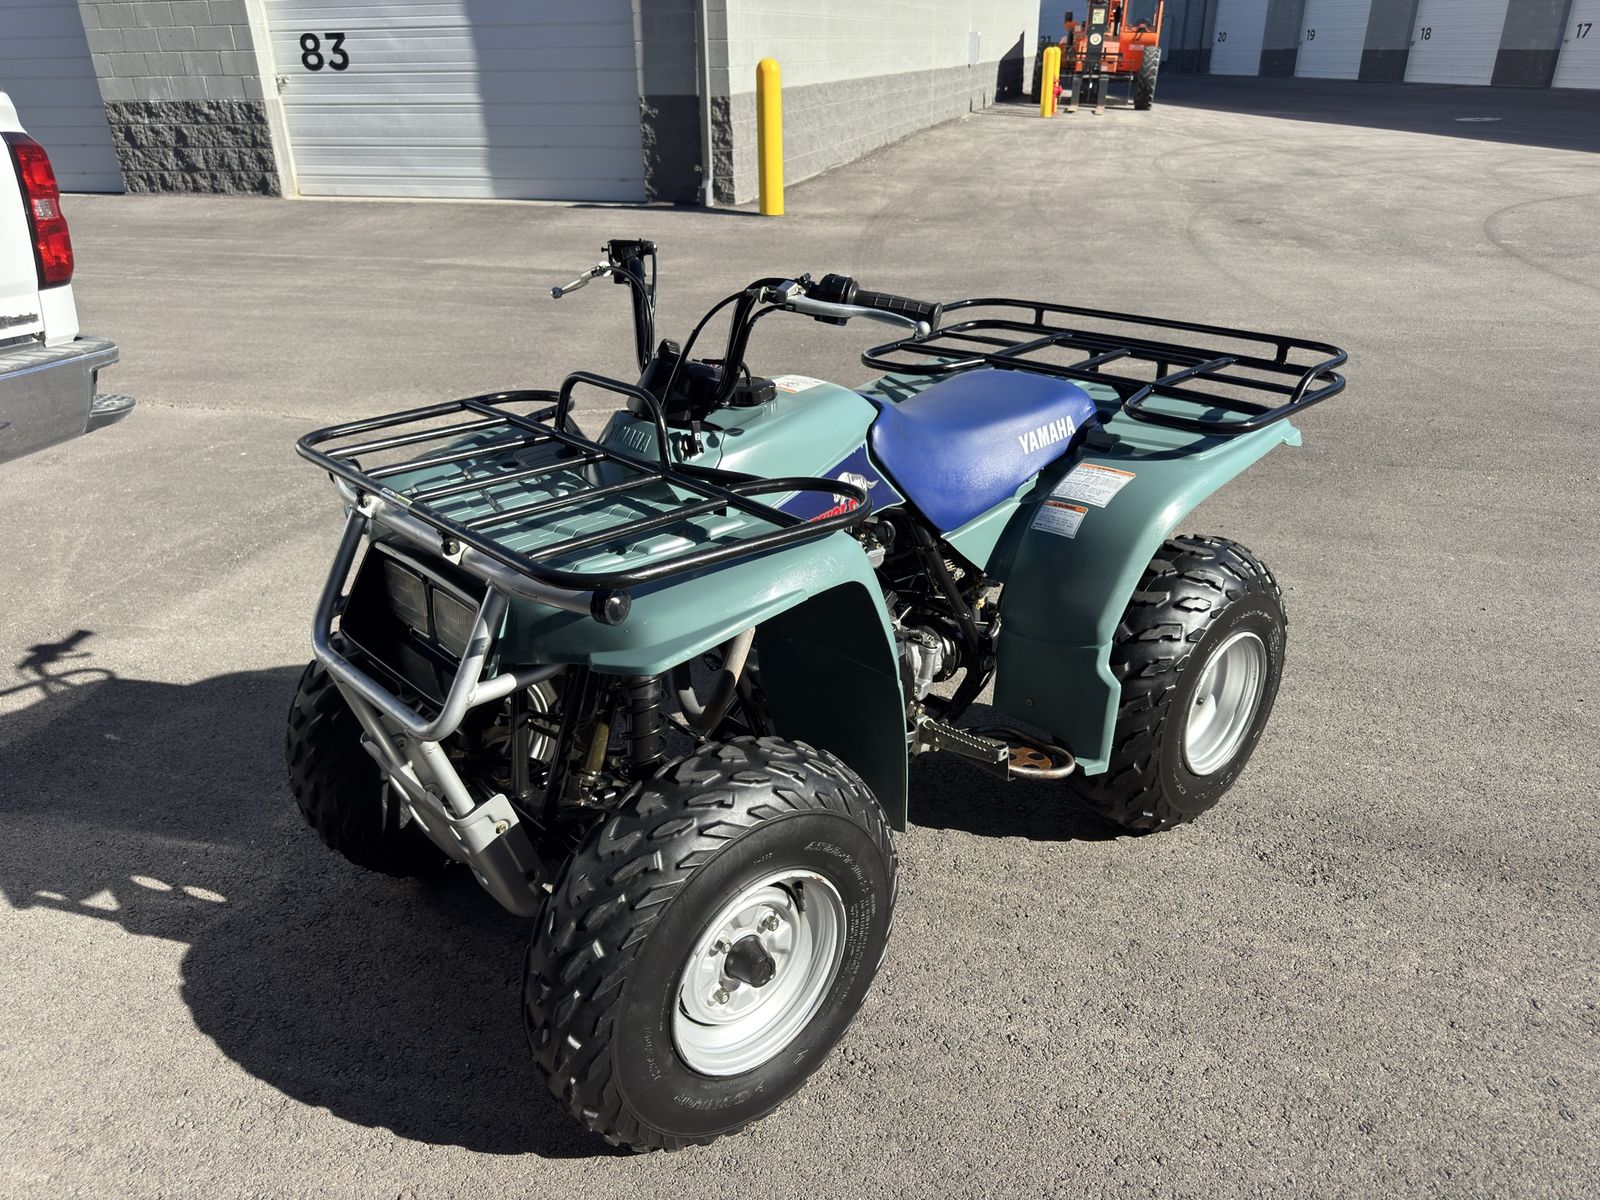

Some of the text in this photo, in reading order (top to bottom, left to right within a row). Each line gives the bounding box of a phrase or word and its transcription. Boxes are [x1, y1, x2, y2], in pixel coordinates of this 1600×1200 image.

[1217, 32, 1227, 42] 20
[1306, 29, 1316, 41] 19
[1420, 27, 1432, 41] 18
[1576, 23, 1592, 39] 17
[300, 32, 350, 71] 83
[1018, 415, 1076, 455] YAMAHA
